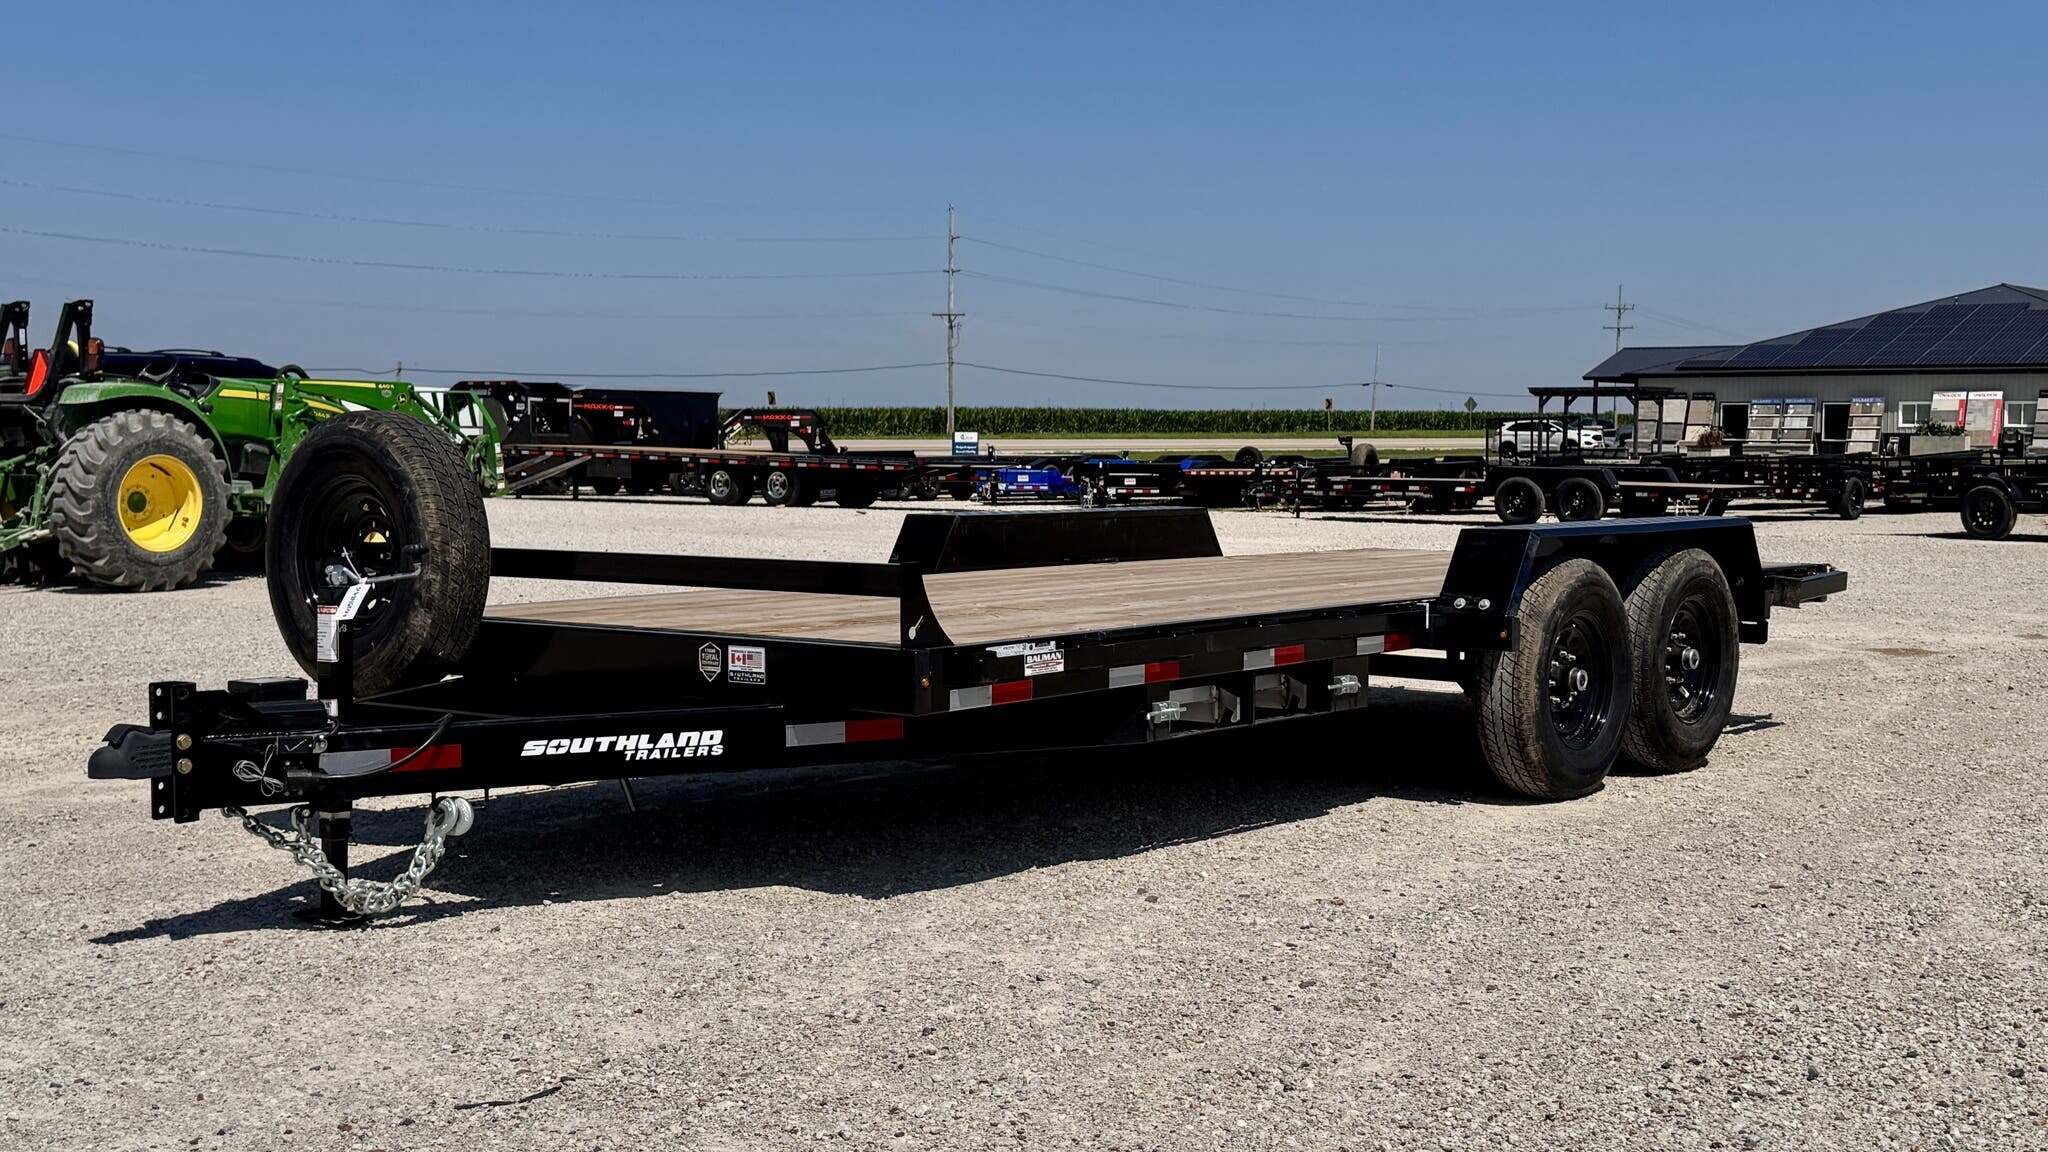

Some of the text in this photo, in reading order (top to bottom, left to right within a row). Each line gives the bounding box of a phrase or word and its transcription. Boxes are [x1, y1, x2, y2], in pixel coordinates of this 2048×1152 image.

[702, 653, 719, 661] TOTAL
[1026, 652, 1062, 664] BAUMAN
[520, 730, 723, 757] SOUTHLAND
[625, 744, 724, 761] TRAILERS
